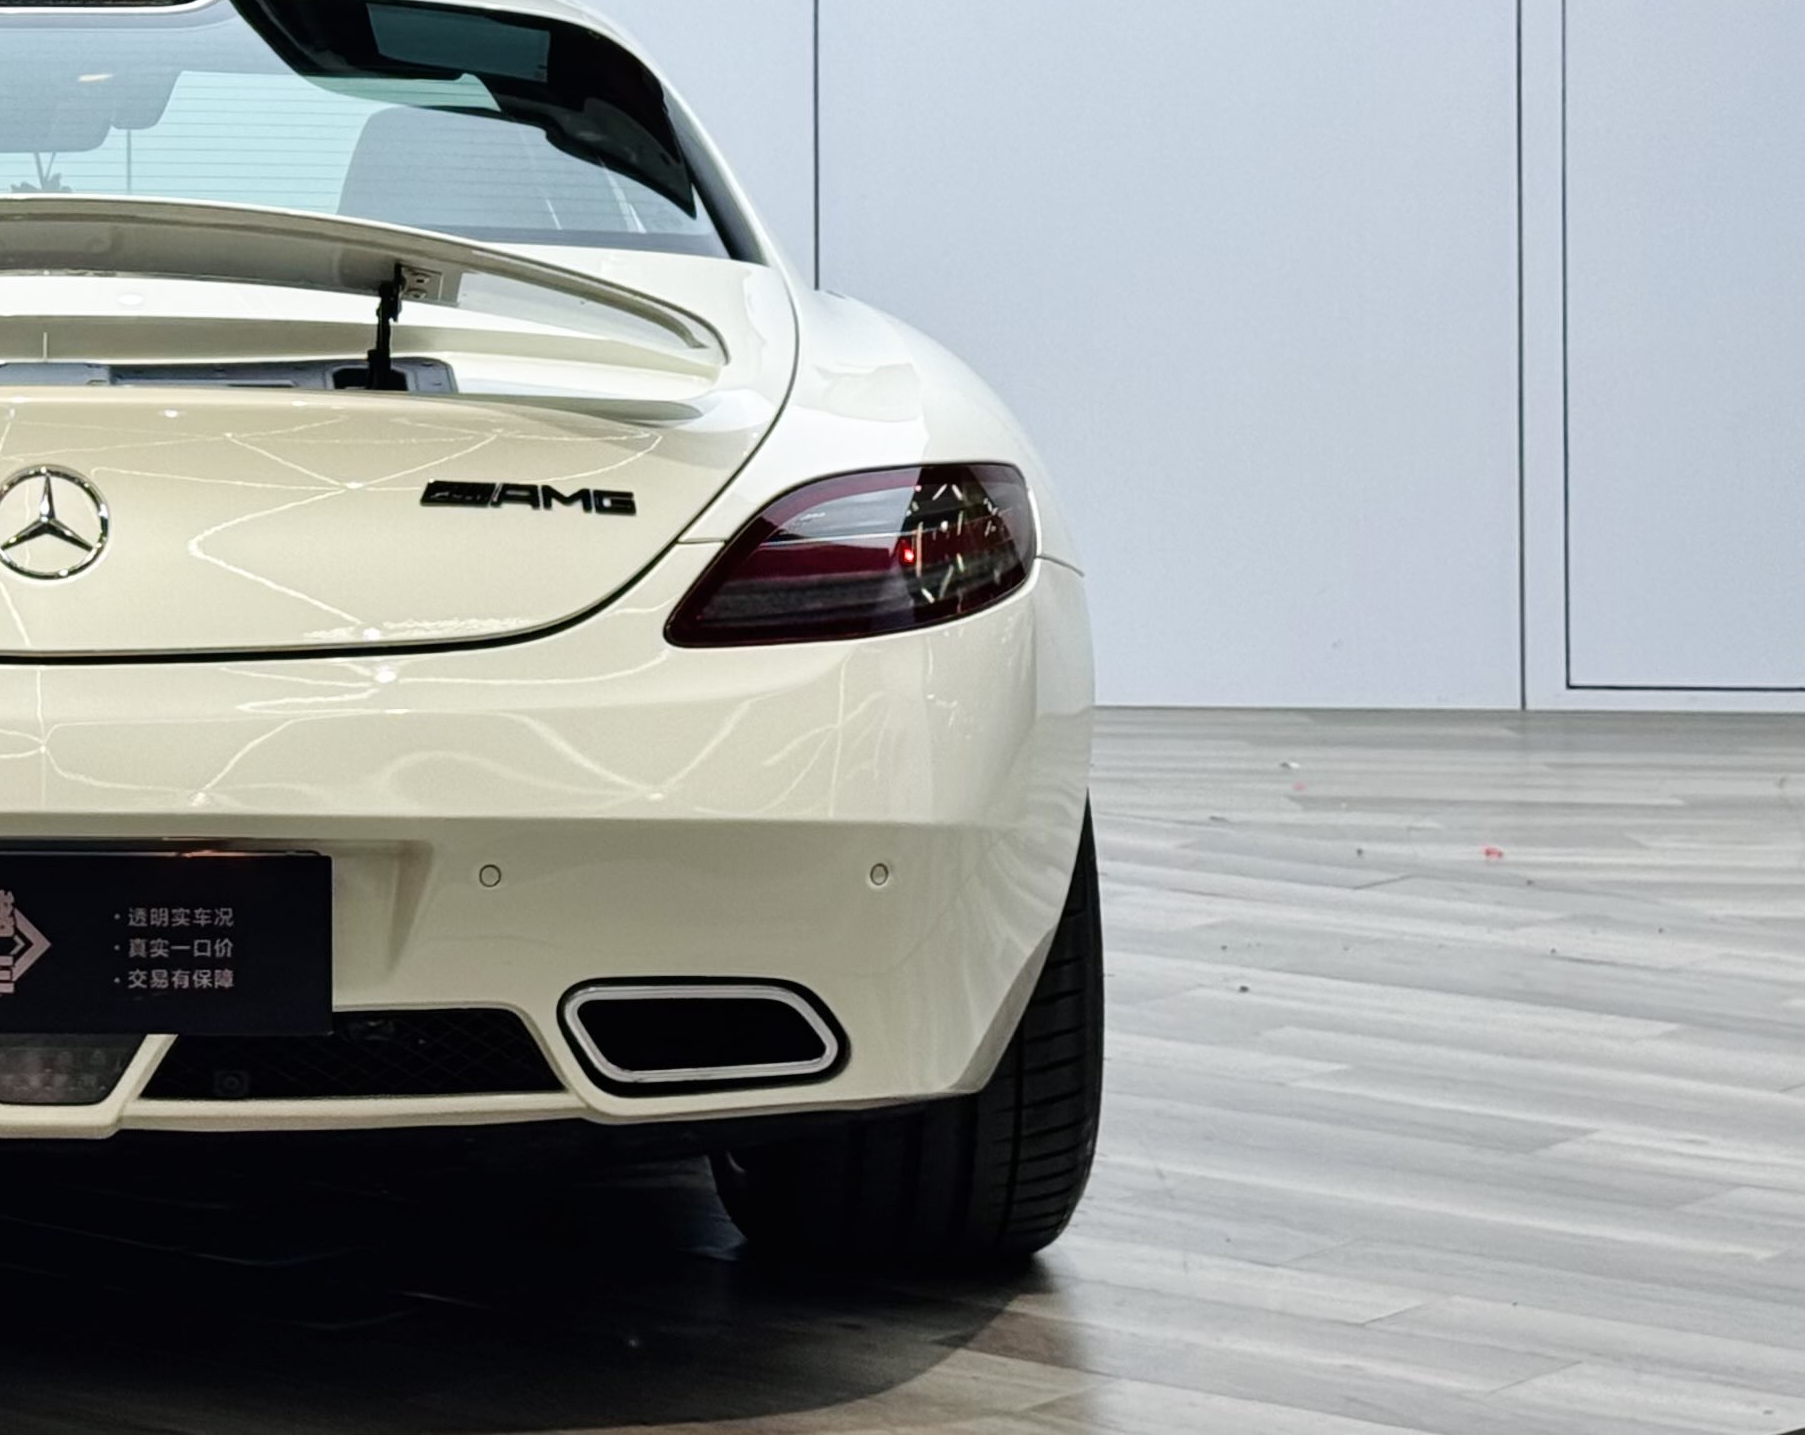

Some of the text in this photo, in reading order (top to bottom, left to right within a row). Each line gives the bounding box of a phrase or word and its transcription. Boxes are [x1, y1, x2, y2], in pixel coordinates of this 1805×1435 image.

[490, 482, 637, 516] AMG
[128, 907, 234, 926] 透明实车况
[128, 938, 234, 958] 真实一口价
[128, 968, 234, 989] 交易有保障
